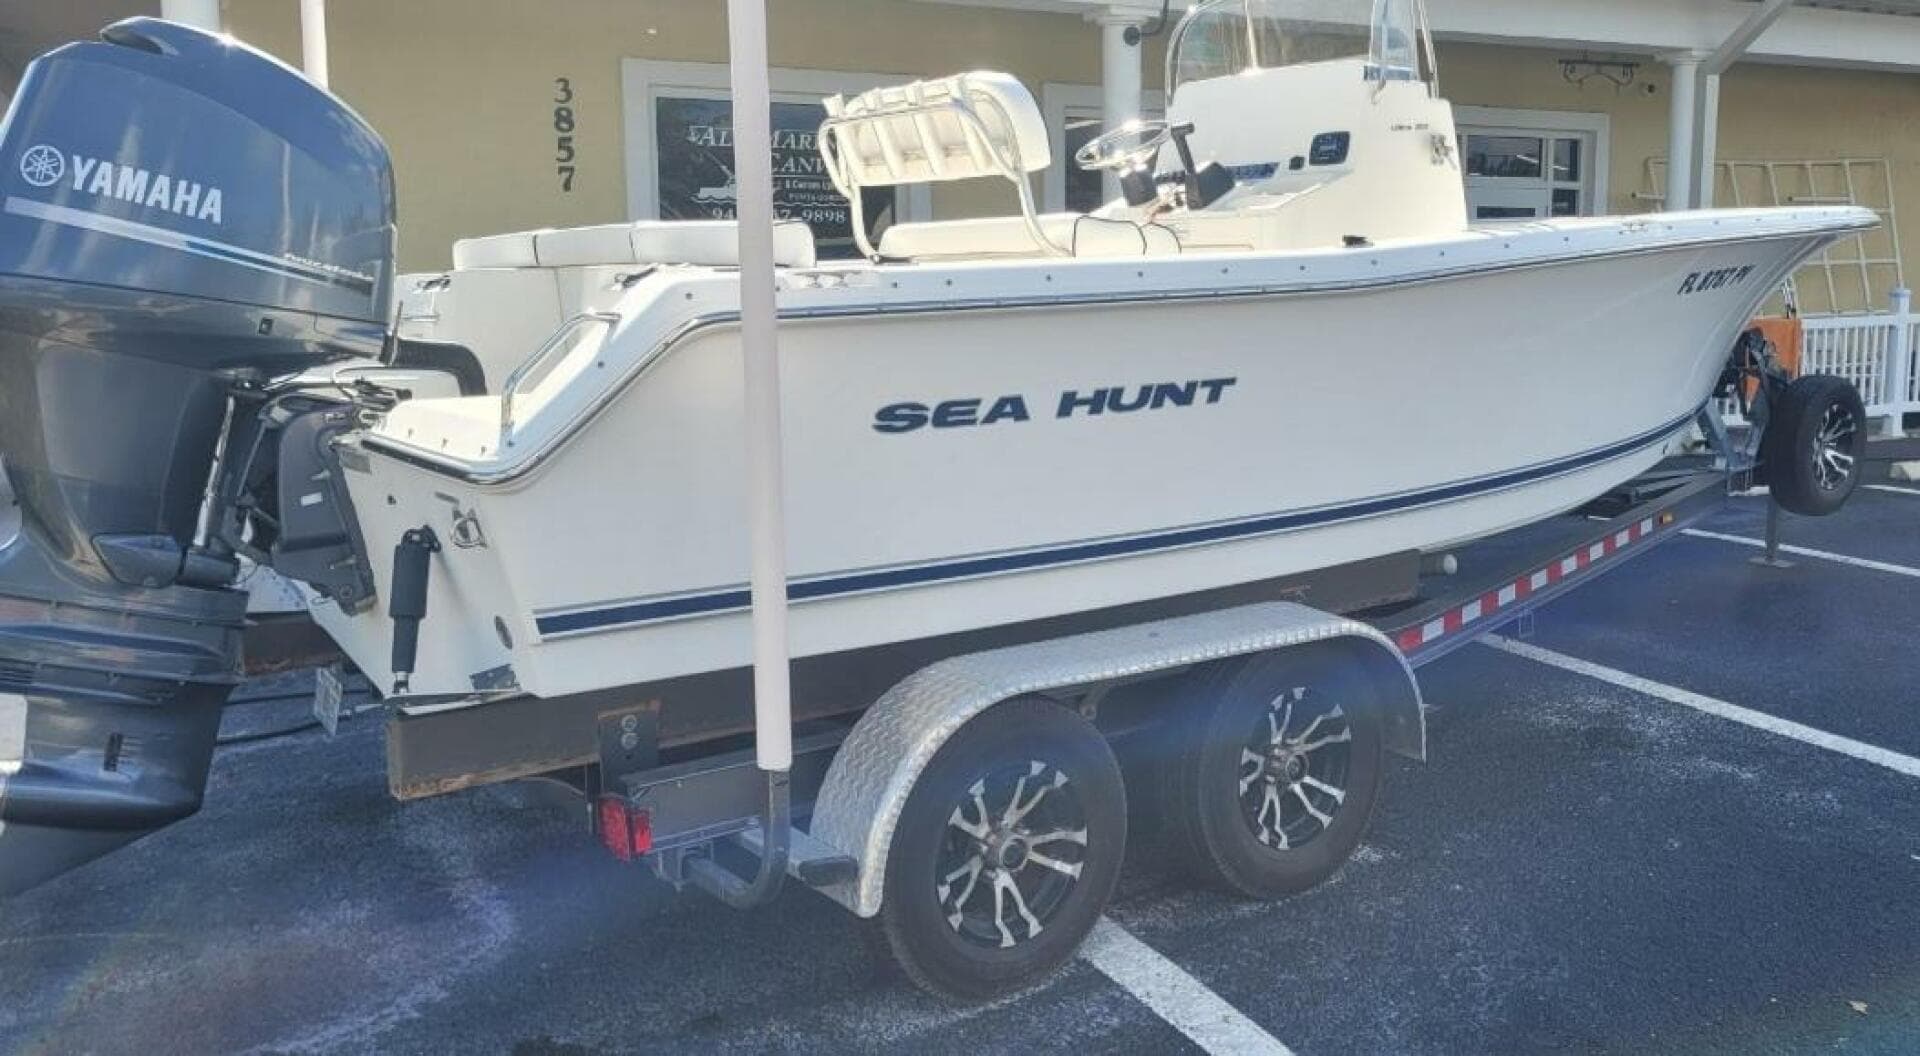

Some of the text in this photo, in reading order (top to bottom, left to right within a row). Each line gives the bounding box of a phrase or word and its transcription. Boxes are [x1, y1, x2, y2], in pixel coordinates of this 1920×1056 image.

[553, 77, 575, 192] 3857
[72, 154, 222, 225] YAMAHA
[802, 208, 846, 223] 9898
[872, 377, 1237, 433] SEA HUNT
